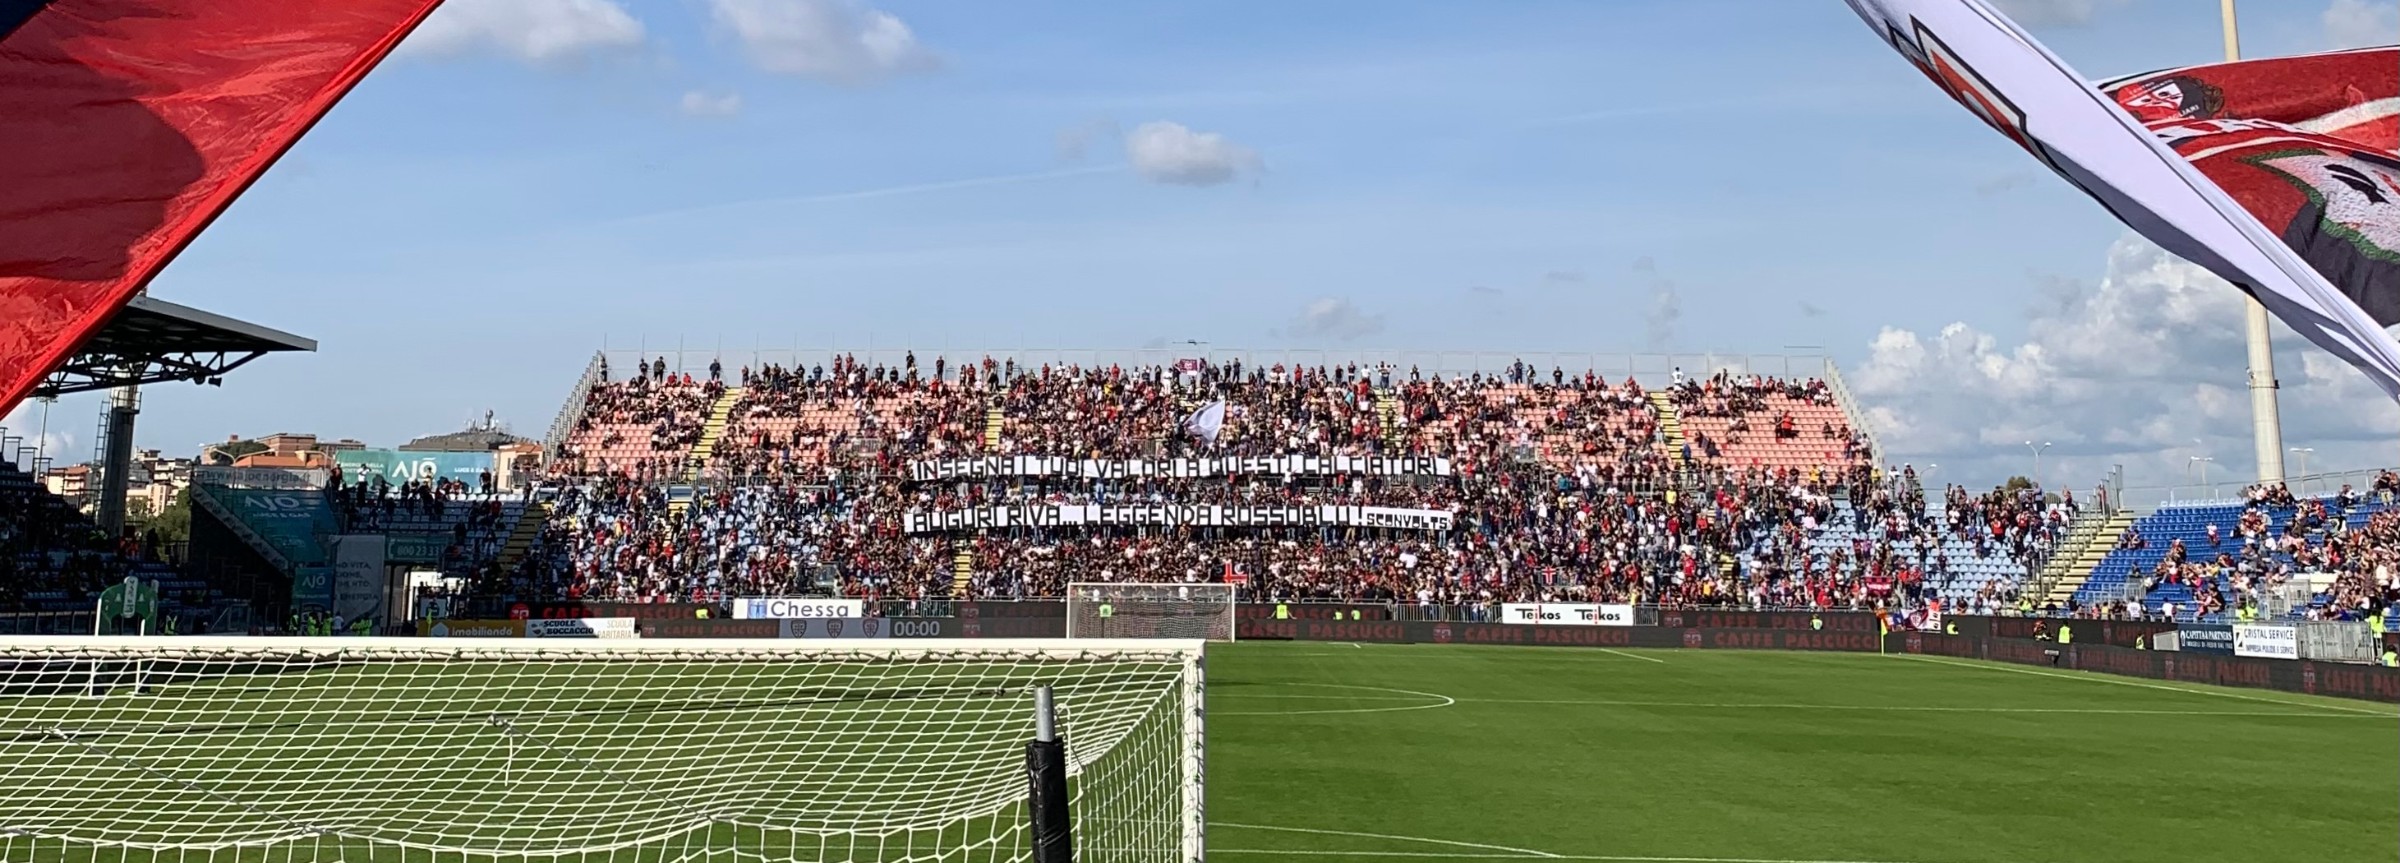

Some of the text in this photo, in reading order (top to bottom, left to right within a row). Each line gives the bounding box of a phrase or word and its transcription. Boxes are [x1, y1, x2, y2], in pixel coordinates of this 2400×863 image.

[916, 457, 1015, 480] INSEGNA
[1036, 456, 1084, 477] TUOI
[1094, 458, 1177, 478] VALORI
[1186, 458, 1201, 477] A
[1209, 455, 1292, 475] QUESTI
[1302, 456, 1438, 475] CALCIATORI
[914, 507, 998, 532] AUGURI
[1084, 504, 1211, 525] LEGGENDA
[1366, 513, 1448, 529] SCONVOLTS
[771, 601, 849, 617] Chessa
[1515, 605, 1561, 622] Teikos
[1574, 606, 1621, 624] Teikos
[547, 627, 594, 635] BOCCACCIO
[894, 621, 940, 637] 00:00
[2244, 628, 2294, 640] CRISTAL SERVICE
